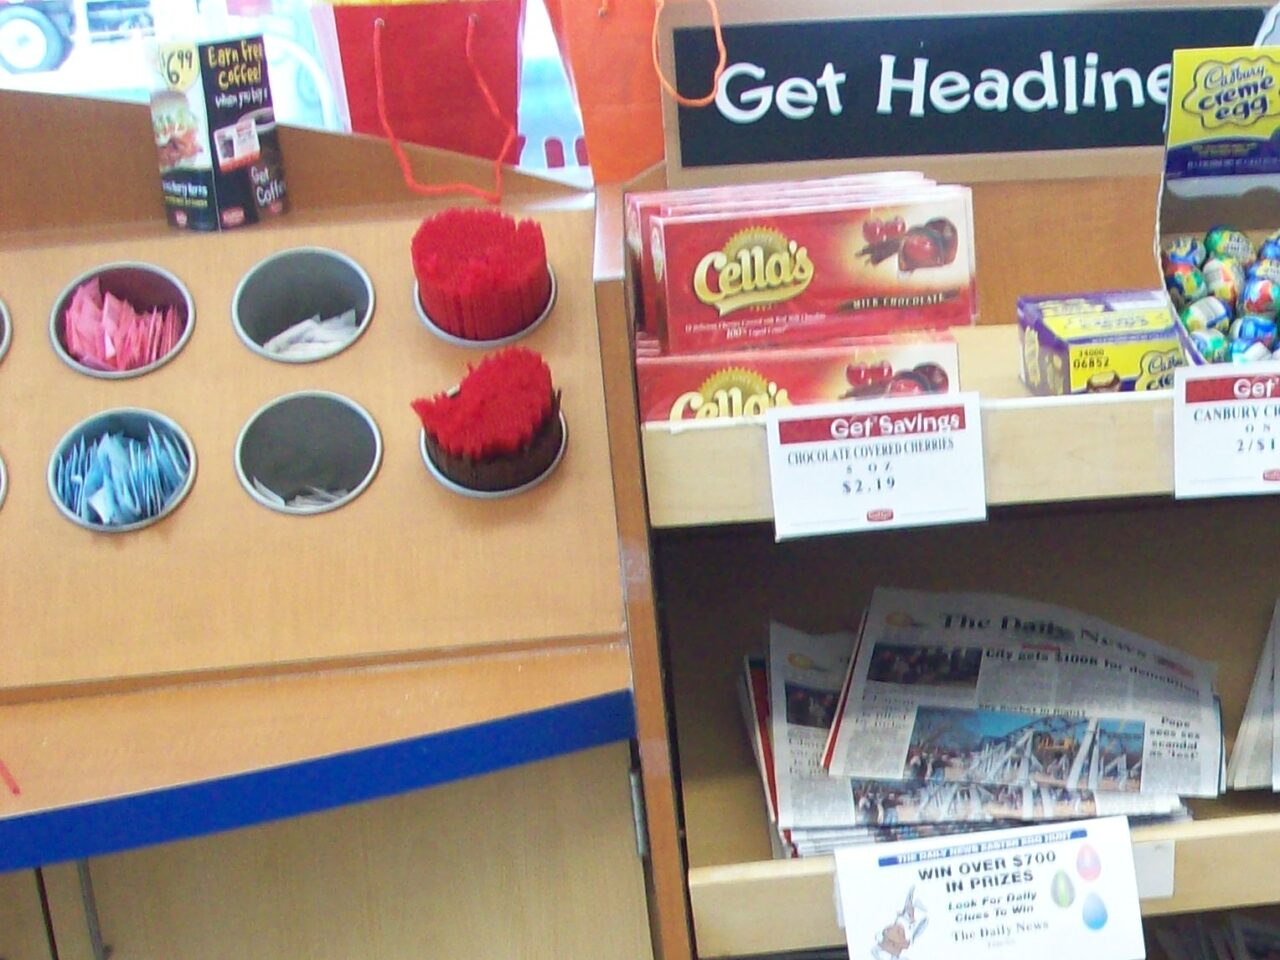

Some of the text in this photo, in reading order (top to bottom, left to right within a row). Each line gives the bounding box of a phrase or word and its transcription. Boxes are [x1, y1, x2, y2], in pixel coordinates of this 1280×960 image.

[208, 44, 240, 68] Earn
[716, 51, 1172, 123] Get Headline
[1204, 65, 1264, 89] Cadbury
[1198, 75, 1274, 111] creme
[1215, 94, 1268, 120] egg
[693, 239, 815, 306] Cella's
[853, 292, 945, 309] MILK CHOCOLATE
[1233, 378, 1275, 399] Get
[830, 412, 960, 439] Get Savings
[1193, 405, 1259, 422] CANBURY
[787, 438, 954, 465] CHOCOLATE COVERED CHERRIES
[842, 476, 895, 494] $2.19
[943, 613, 1149, 659] The Daily News
[918, 850, 1057, 880] WIN OVER $700
[946, 869, 1034, 893] IN PRIZES
[948, 891, 1037, 910] Look For Daily
[995, 908, 1007, 917] To
[1012, 904, 1034, 914] Win
[952, 920, 1049, 941] The Daily News
